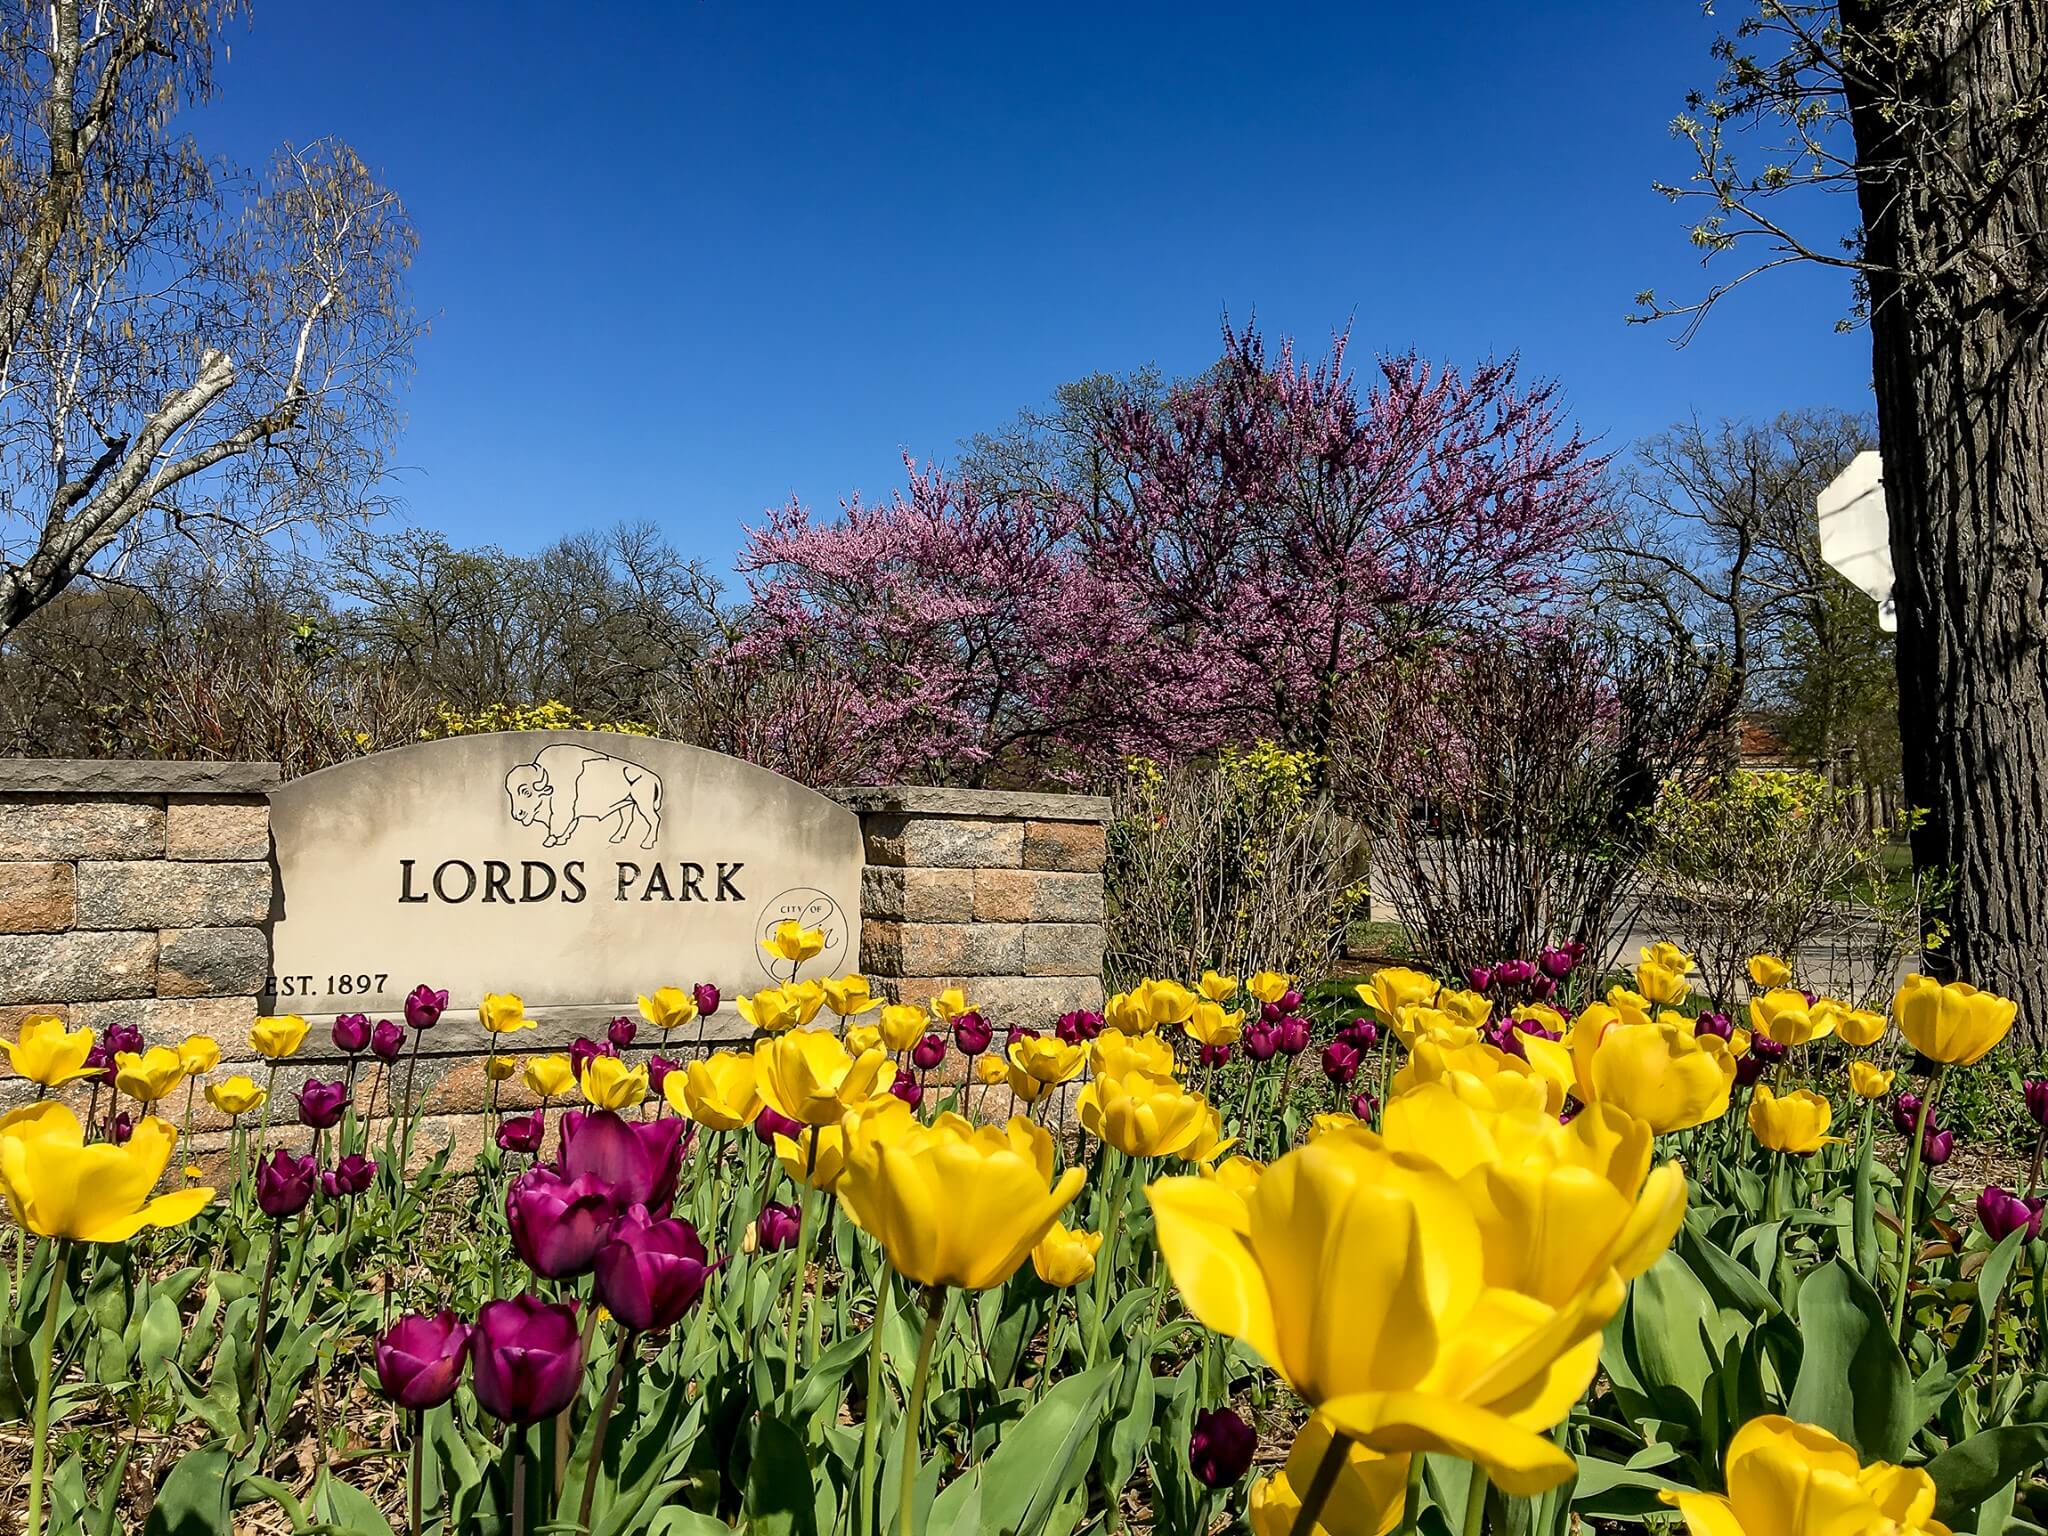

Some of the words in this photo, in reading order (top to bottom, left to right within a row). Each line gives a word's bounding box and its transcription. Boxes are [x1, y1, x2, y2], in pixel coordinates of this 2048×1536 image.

[398, 859, 587, 904] LORDS
[614, 861, 747, 902] PARK
[780, 905, 803, 913] CITY
[810, 905, 822, 913] OF
[264, 975, 317, 997] EST.
[326, 973, 389, 995] 1897
